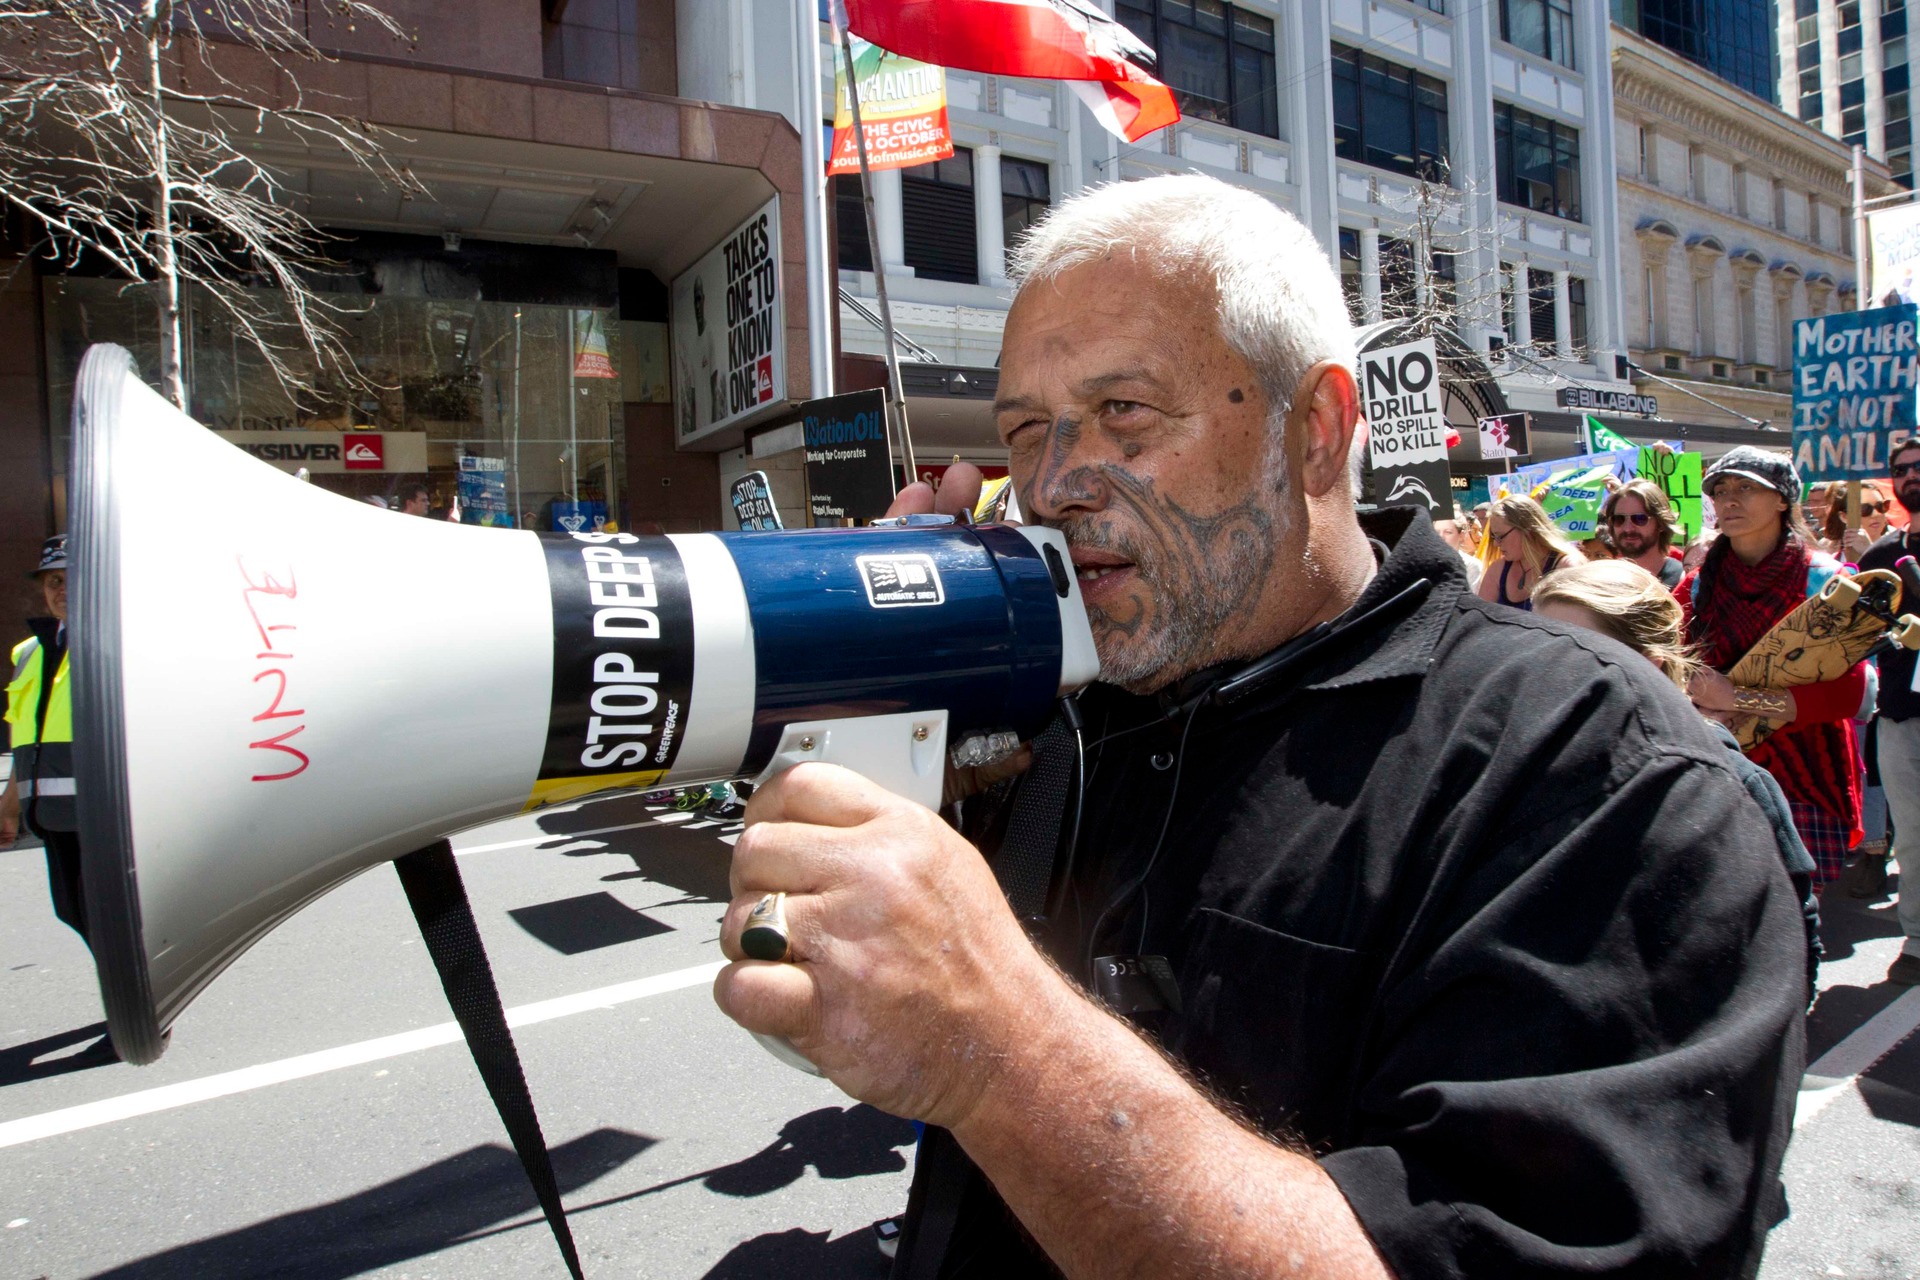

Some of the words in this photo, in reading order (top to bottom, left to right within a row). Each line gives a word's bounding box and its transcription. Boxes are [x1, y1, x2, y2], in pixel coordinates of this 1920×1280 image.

[862, 124, 889, 137] THE
[892, 117, 933, 134] CIVIC
[844, 138, 873, 152] 3-6
[875, 128, 945, 149] OCTOBER
[723, 213, 769, 285] TAKES
[726, 272, 753, 328] ONE
[754, 257, 775, 310] TO
[728, 305, 773, 372] KNOW
[1797, 318, 1916, 358] MOTHER
[1366, 351, 1433, 399] NO
[1801, 355, 1917, 397] EARTH
[729, 362, 757, 415] ONE
[1370, 392, 1437, 421] DRILL
[1579, 389, 1657, 413] BILLABONG
[1796, 399, 1832, 431] IS
[1838, 394, 1903, 429] NOT
[1371, 422, 1393, 437] NO
[1397, 416, 1438, 433] SPILL
[235, 443, 341, 461] KSILVER
[1373, 437, 1398, 455] NO
[1402, 431, 1441, 450] KILL
[806, 450, 825, 465] Working
[833, 448, 867, 462] Corporates
[1644, 449, 1676, 477] NO
[737, 479, 757, 502] STOP
[1562, 488, 1596, 499] DEEP
[738, 501, 755, 519] DEEP
[756, 499, 770, 515] SEA
[1548, 505, 1574, 520] SEA
[751, 516, 766, 531] OIL
[1568, 521, 1589, 531] OIL
[581, 546, 660, 639] DEEP
[875, 591, 916, 601] AUTOMATIC
[580, 652, 659, 769] STOP
[655, 700, 679, 764] GREENPEACE
